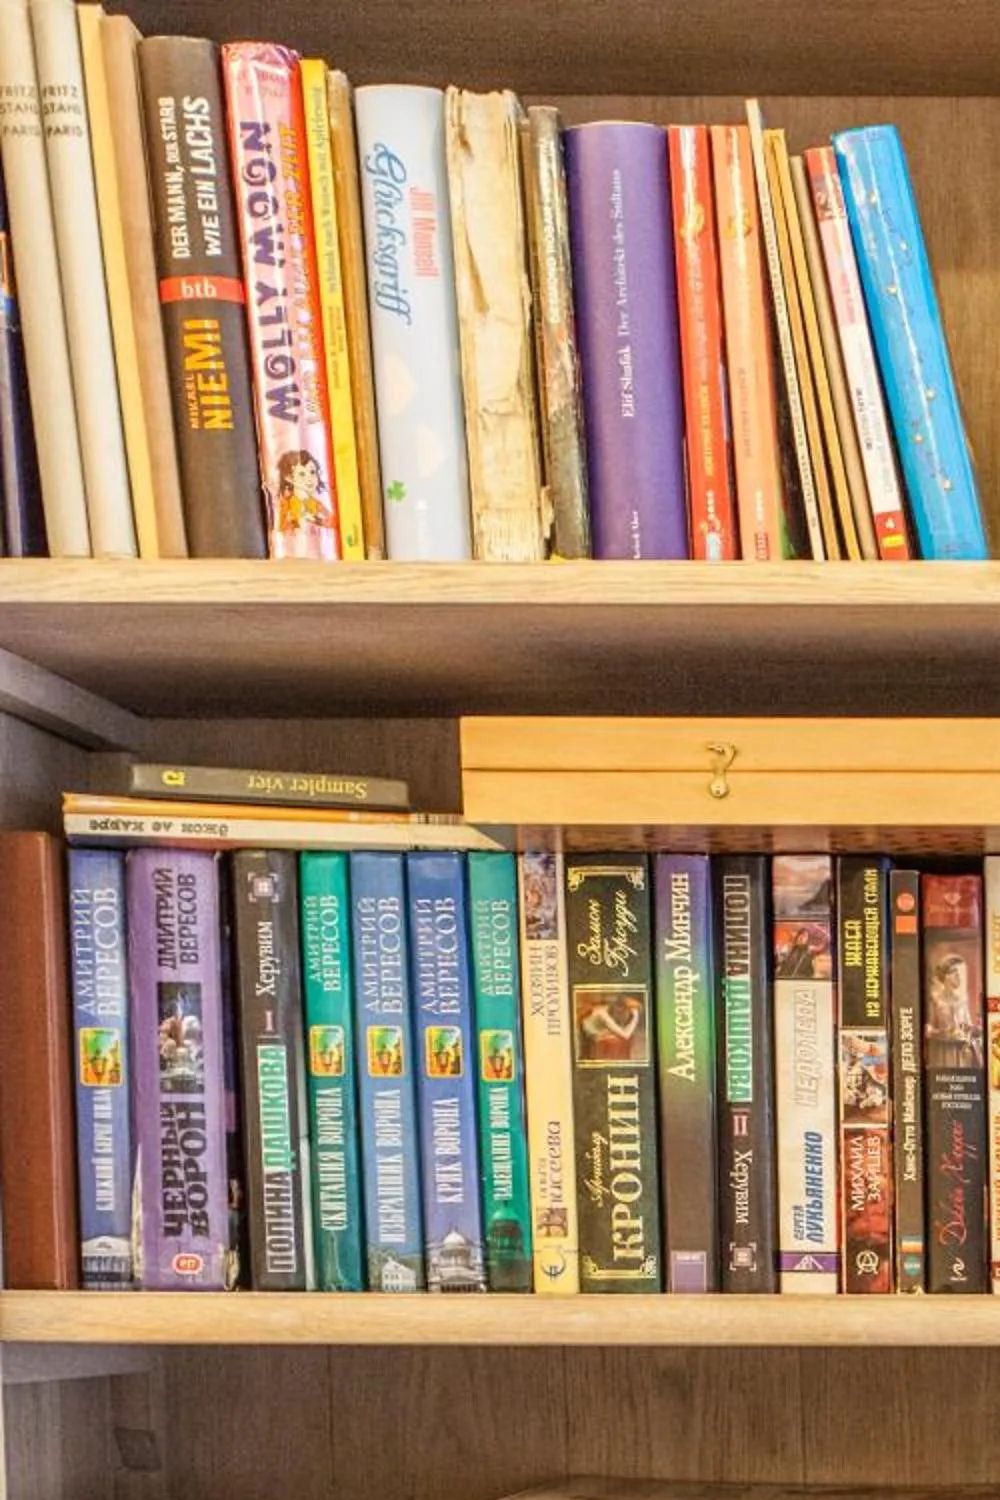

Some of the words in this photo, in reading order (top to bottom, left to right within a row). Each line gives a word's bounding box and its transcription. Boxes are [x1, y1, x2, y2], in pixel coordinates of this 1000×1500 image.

[46, 125, 82, 138] PARIS
[157, 96, 178, 142] STARB
[183, 95, 217, 176] LACHS
[163, 167, 187, 223] MANN,
[193, 180, 218, 212] EIN
[200, 215, 223, 258] WIE
[238, 121, 286, 268] MOON
[365, 143, 413, 326] Glücksgriff
[168, 225, 191, 258] DER
[181, 280, 218, 298] btb
[184, 319, 234, 430] NIEMI
[254, 281, 301, 424] MOLLY
[619, 393, 635, 418] Elif
[247, 774, 285, 793] vier
[290, 777, 368, 799] Sampler
[70, 888, 97, 1017] ДМИТРИЙ
[93, 887, 120, 1016] ВЕРЕСОВ
[152, 868, 178, 970] ДМИТРИЙ
[176, 873, 199, 965] ВЕРЕСОВ
[254, 920, 282, 997] Херувим
[303, 895, 323, 982] ДМИТРИЙ
[318, 893, 341, 992] ВЕРЕСОВ
[357, 897, 381, 1016] ДМИТРИЙ
[377, 896, 404, 1015] ВЕРЕСОВ
[412, 898, 437, 1015] ДМИТРИЙ
[433, 896, 461, 1015] ВЕРЕСОВ
[474, 899, 494, 996] ДМИТРИЙ
[490, 898, 514, 997] ВЕРЕСОВ
[577, 899, 604, 966] Замок
[602, 889, 638, 977] Броуди
[663, 872, 693, 963] Минчин
[724, 875, 752, 977] ПОЛИНА
[666, 966, 701, 1081] Александр
[722, 976, 753, 1101] ДАШКОВА
[899, 1007, 914, 1041] ЗОРГЕ
[900, 1043, 916, 1073] ДЕЛО
[258, 1045, 296, 1173] ДАШКОВА
[315, 1087, 344, 1145] ВОРОНА
[373, 1089, 404, 1148] ВОРОНА
[431, 1097, 462, 1156] ВОРОНА
[489, 1087, 511, 1130] ВОРОНА
[159, 1102, 188, 1238] ЧЕРНЫЙ
[176, 1102, 210, 1238] ВОРОН
[318, 1151, 349, 1231] СКИТАНИЯ
[434, 1161, 465, 1204] КРИК
[607, 1073, 646, 1262] КРОНИН
[733, 1149, 754, 1224] Херувим
[803, 1131, 825, 1243] ЛУКЬЯНЕНКО
[850, 1136, 867, 1211] МИХАИЛ
[864, 1136, 882, 1201] ЗАЙЦЕВ
[265, 1170, 294, 1271] ПОЛИНА
